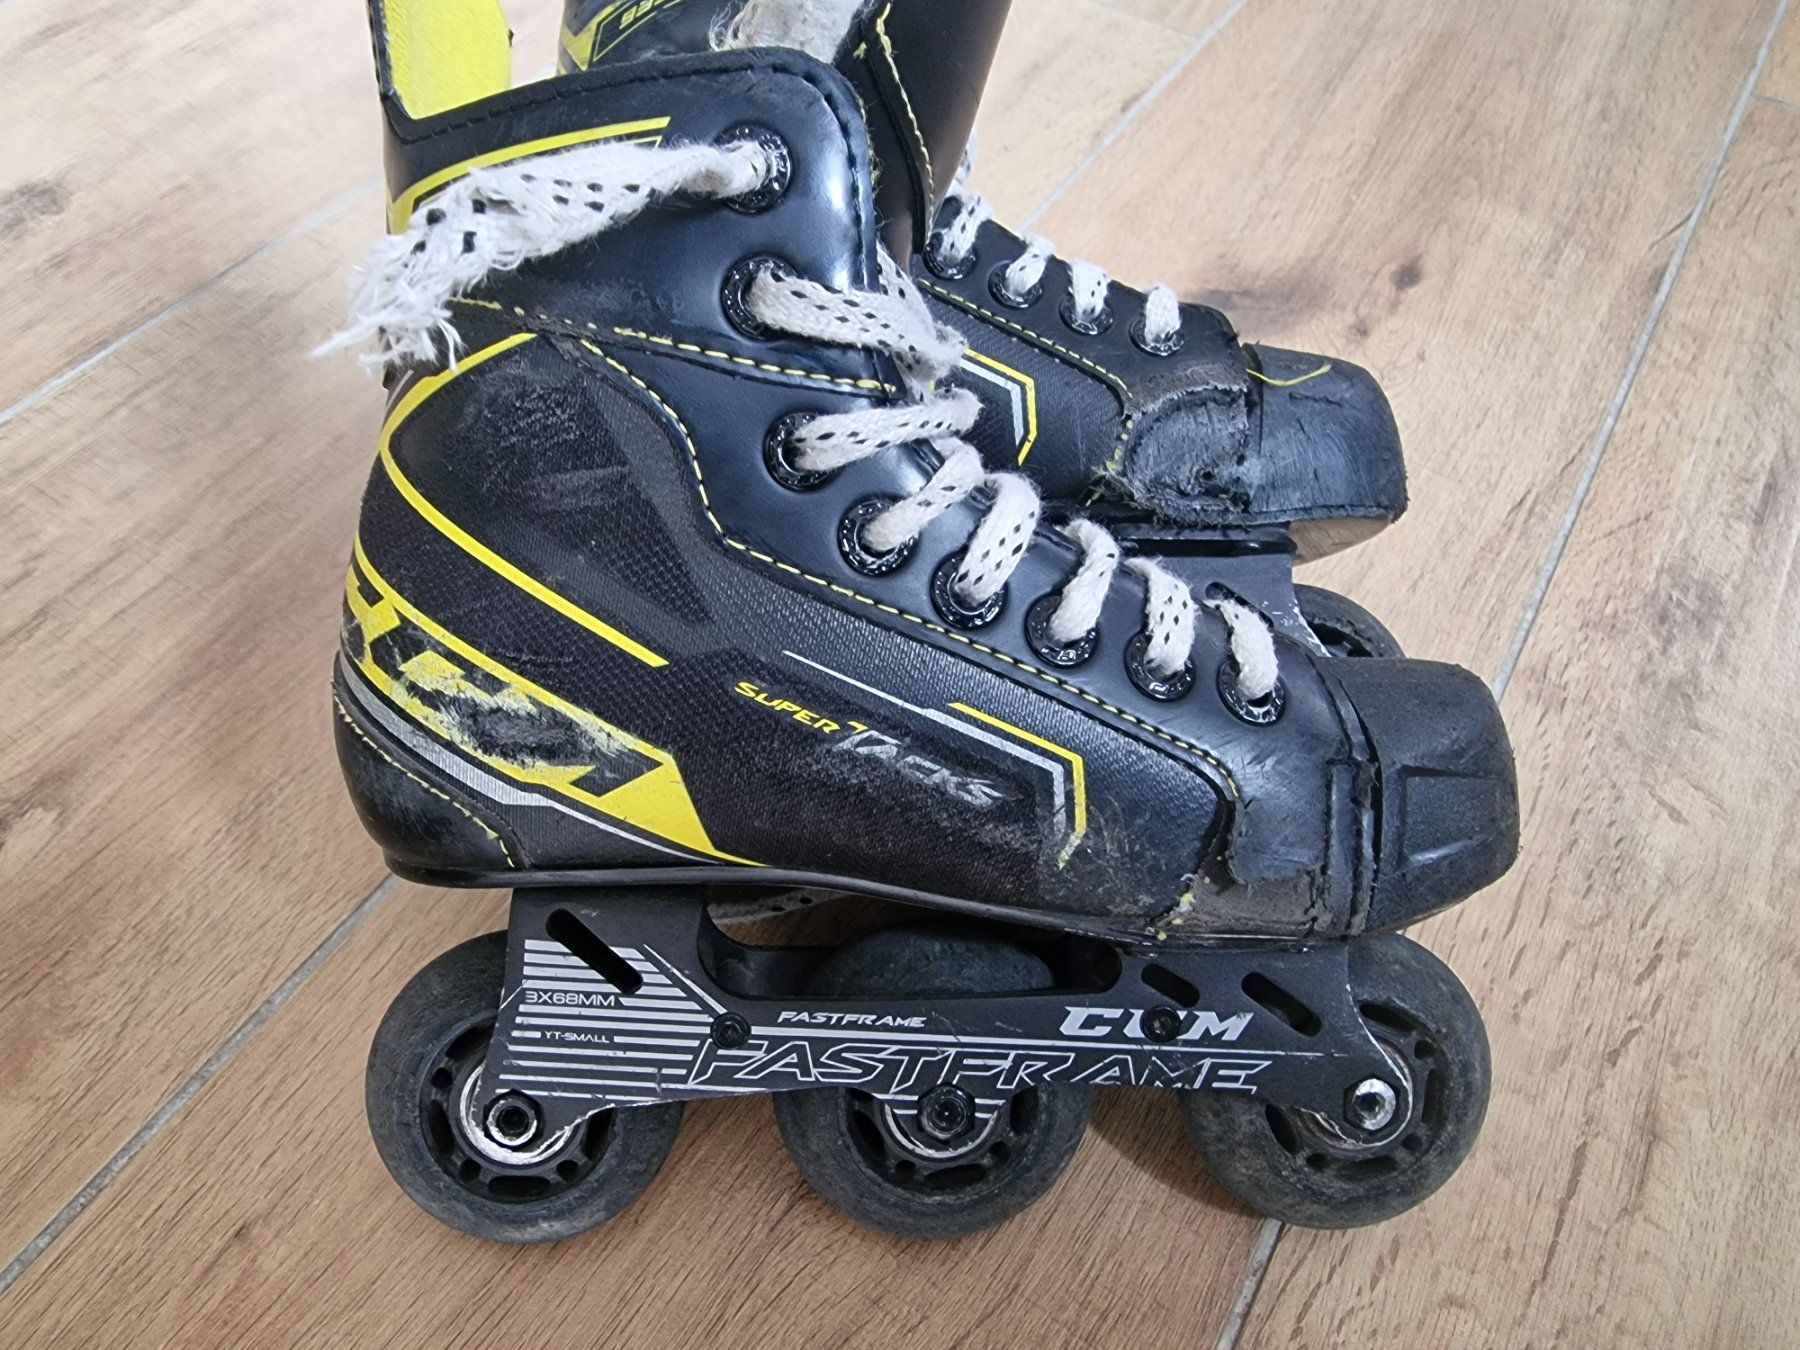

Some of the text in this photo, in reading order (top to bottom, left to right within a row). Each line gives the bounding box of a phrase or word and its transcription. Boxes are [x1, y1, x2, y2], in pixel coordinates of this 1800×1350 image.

[734, 681, 840, 734] SUPER
[525, 991, 615, 1007] 3X68MM
[777, 1011, 927, 1028] FASTFRAME
[544, 1030, 610, 1044] YT-SMALL
[687, 1039, 1273, 1095] FASTFRAME
